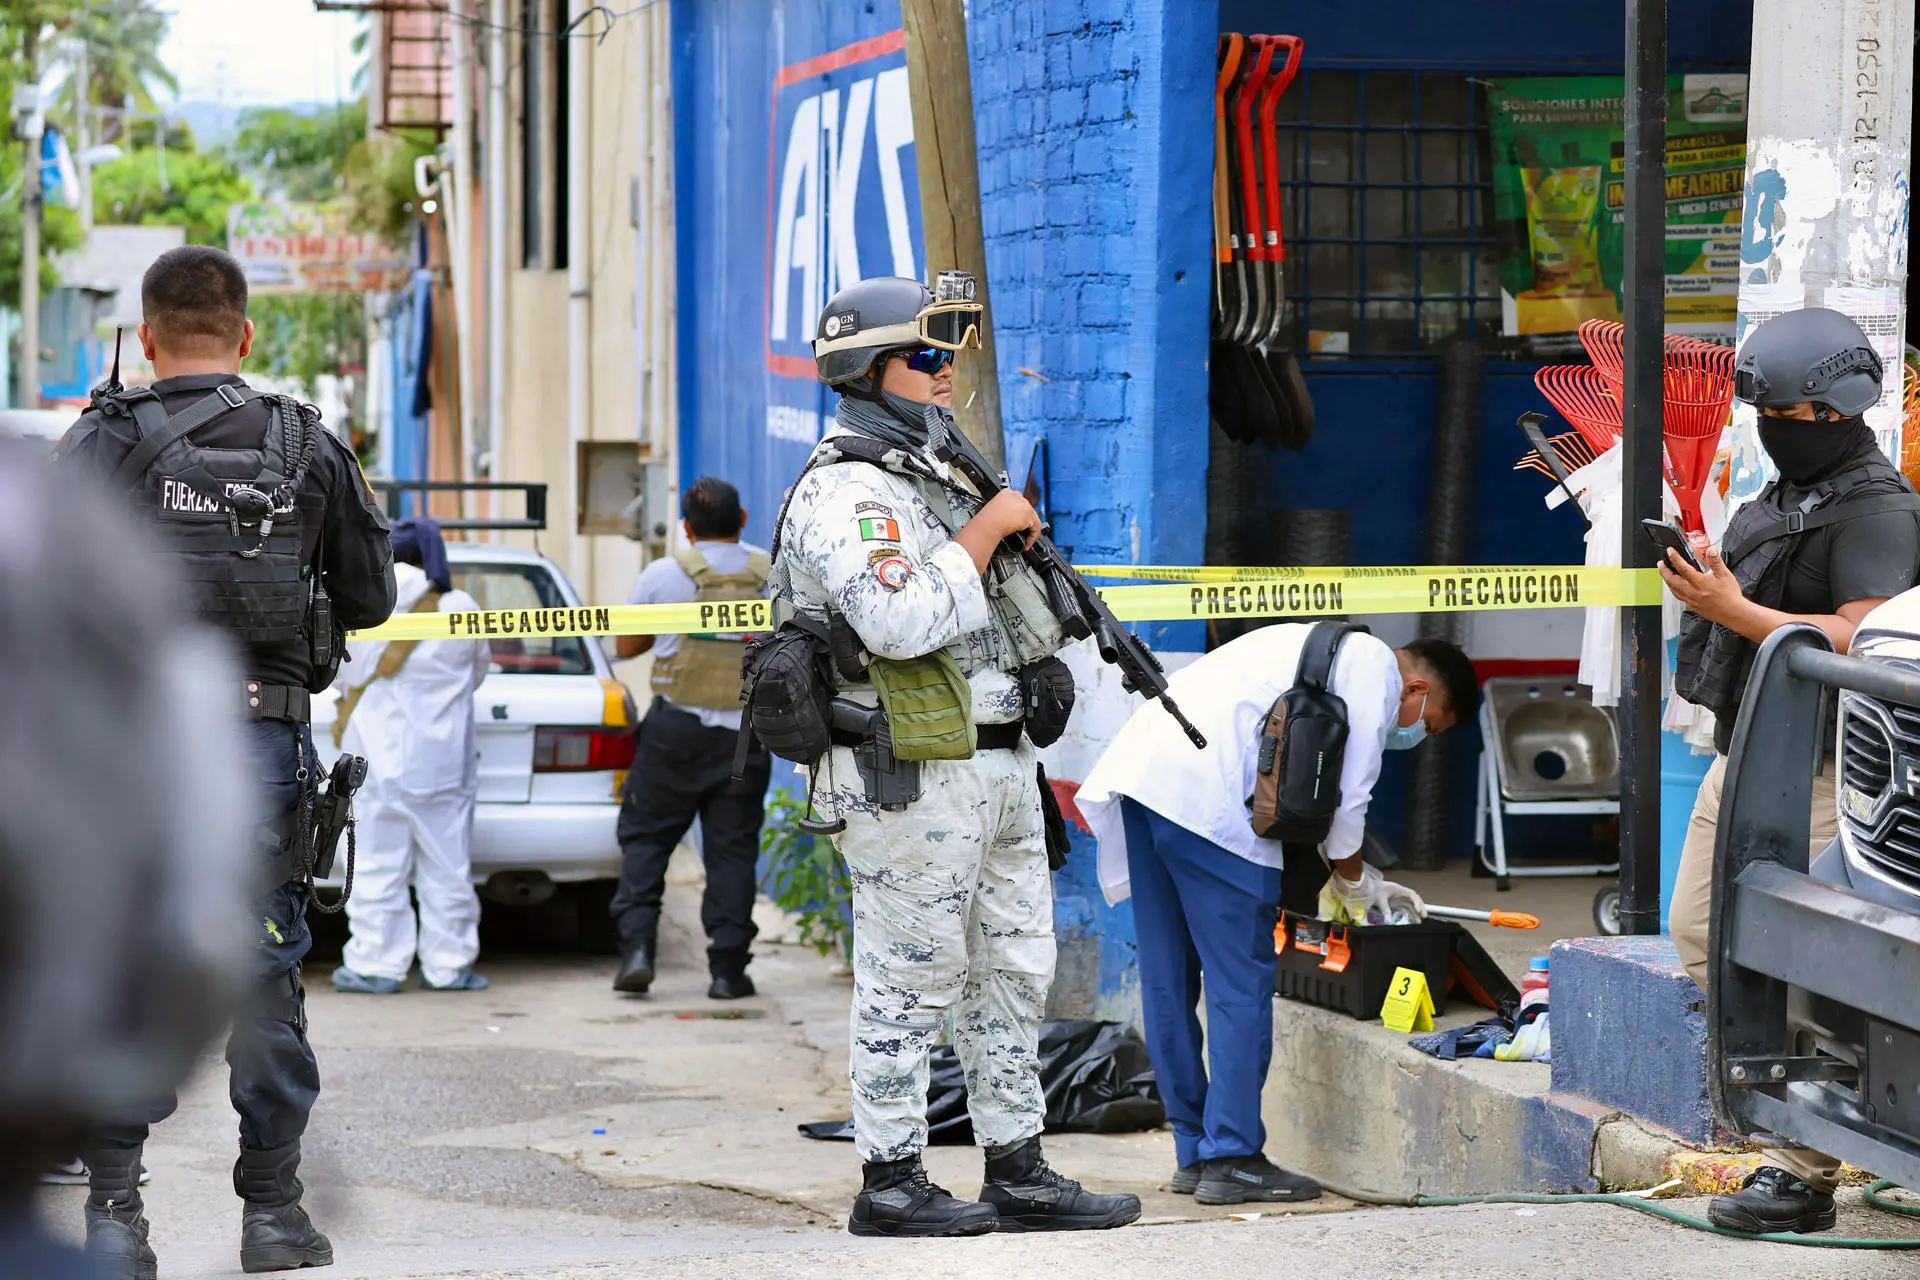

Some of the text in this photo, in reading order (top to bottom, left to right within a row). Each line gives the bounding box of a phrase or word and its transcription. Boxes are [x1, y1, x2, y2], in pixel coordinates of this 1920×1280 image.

[840, 313, 854, 324] GN
[1190, 582, 1343, 615] PRECAUCION
[1428, 574, 1579, 607] PRECAUCION
[449, 608, 611, 635] PRECAUCION
[700, 603, 773, 629] PREC
[1316, 751, 1324, 776] FASHION
[1399, 976, 1411, 996] 3
